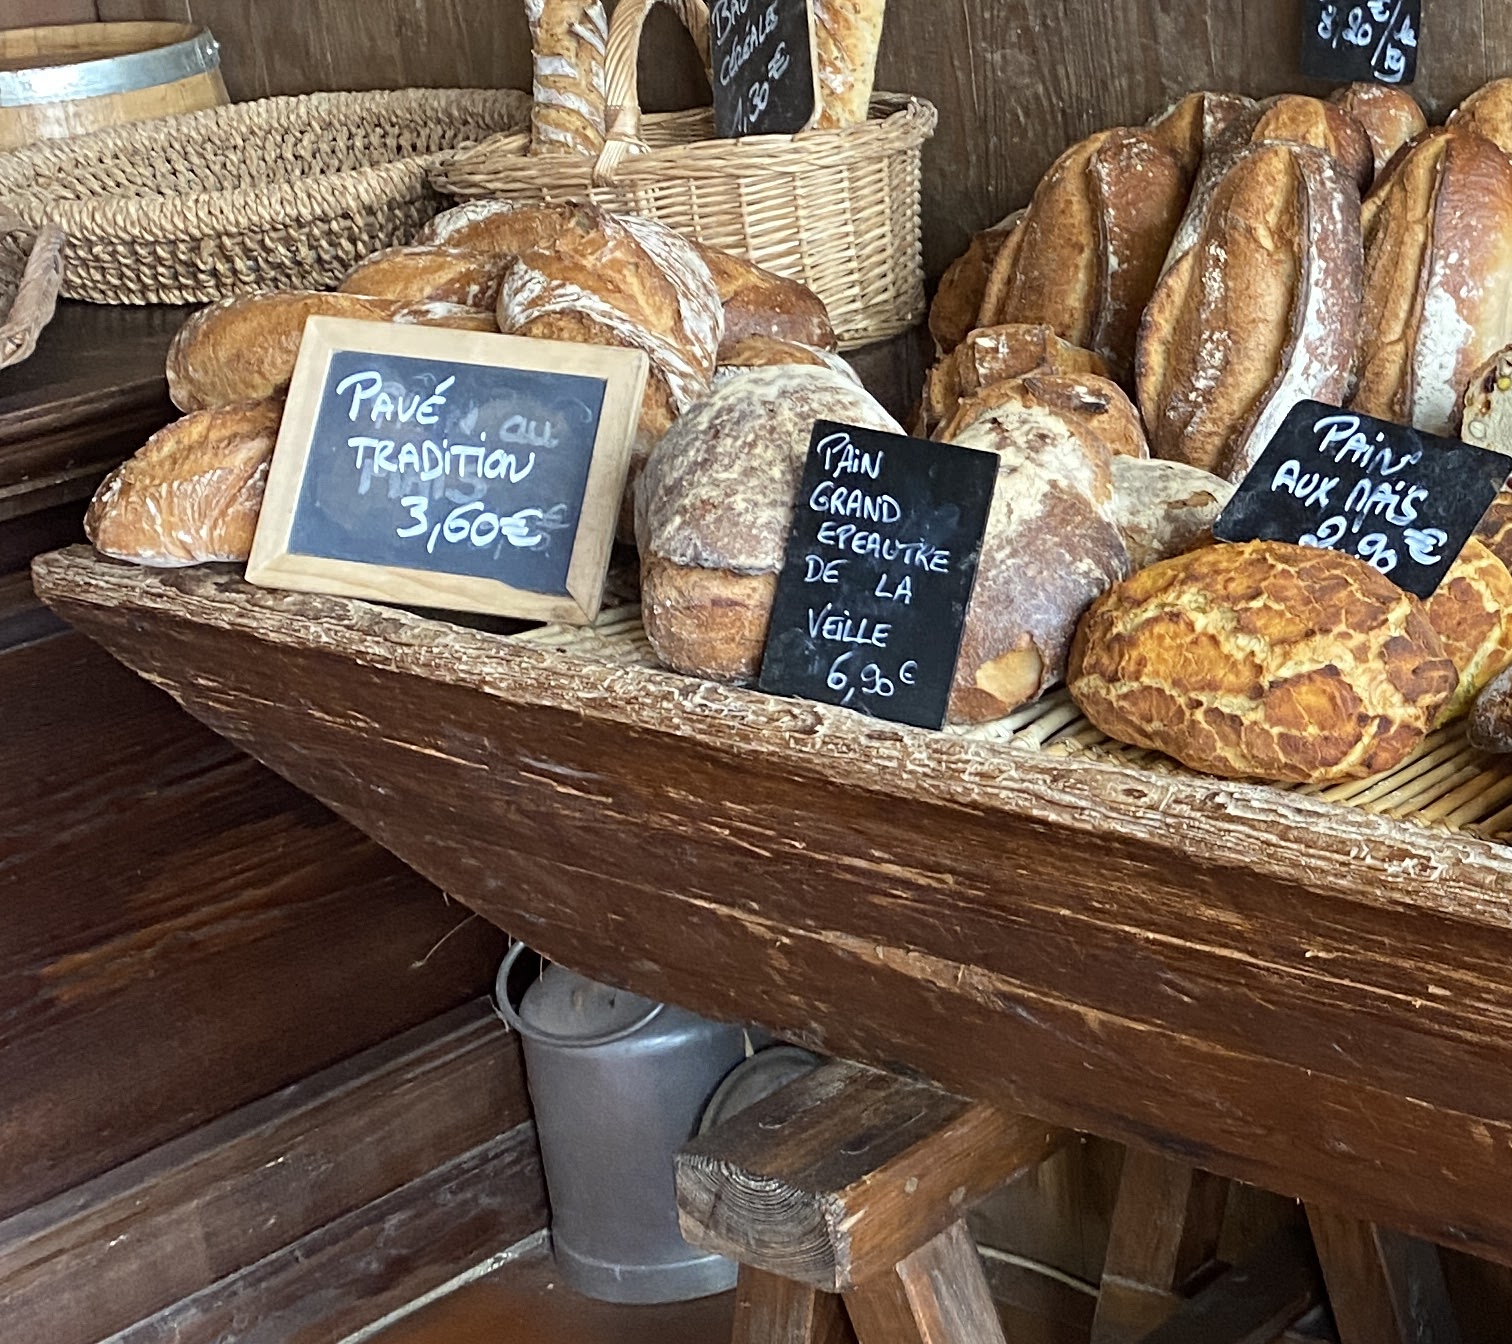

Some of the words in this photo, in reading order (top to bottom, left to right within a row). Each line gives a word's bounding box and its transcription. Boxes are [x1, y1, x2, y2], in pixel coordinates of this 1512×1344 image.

[336, 370, 456, 426] PAVÉ
[809, 481, 902, 524] GRAND
[1271, 459, 1340, 508] AUX
[396, 495, 543, 554] 3,60€
[816, 522, 951, 574] EPEAUTRE
[804, 554, 849, 584] DE
[875, 573, 913, 605] LA
[826, 651, 918, 706] 6,90€
